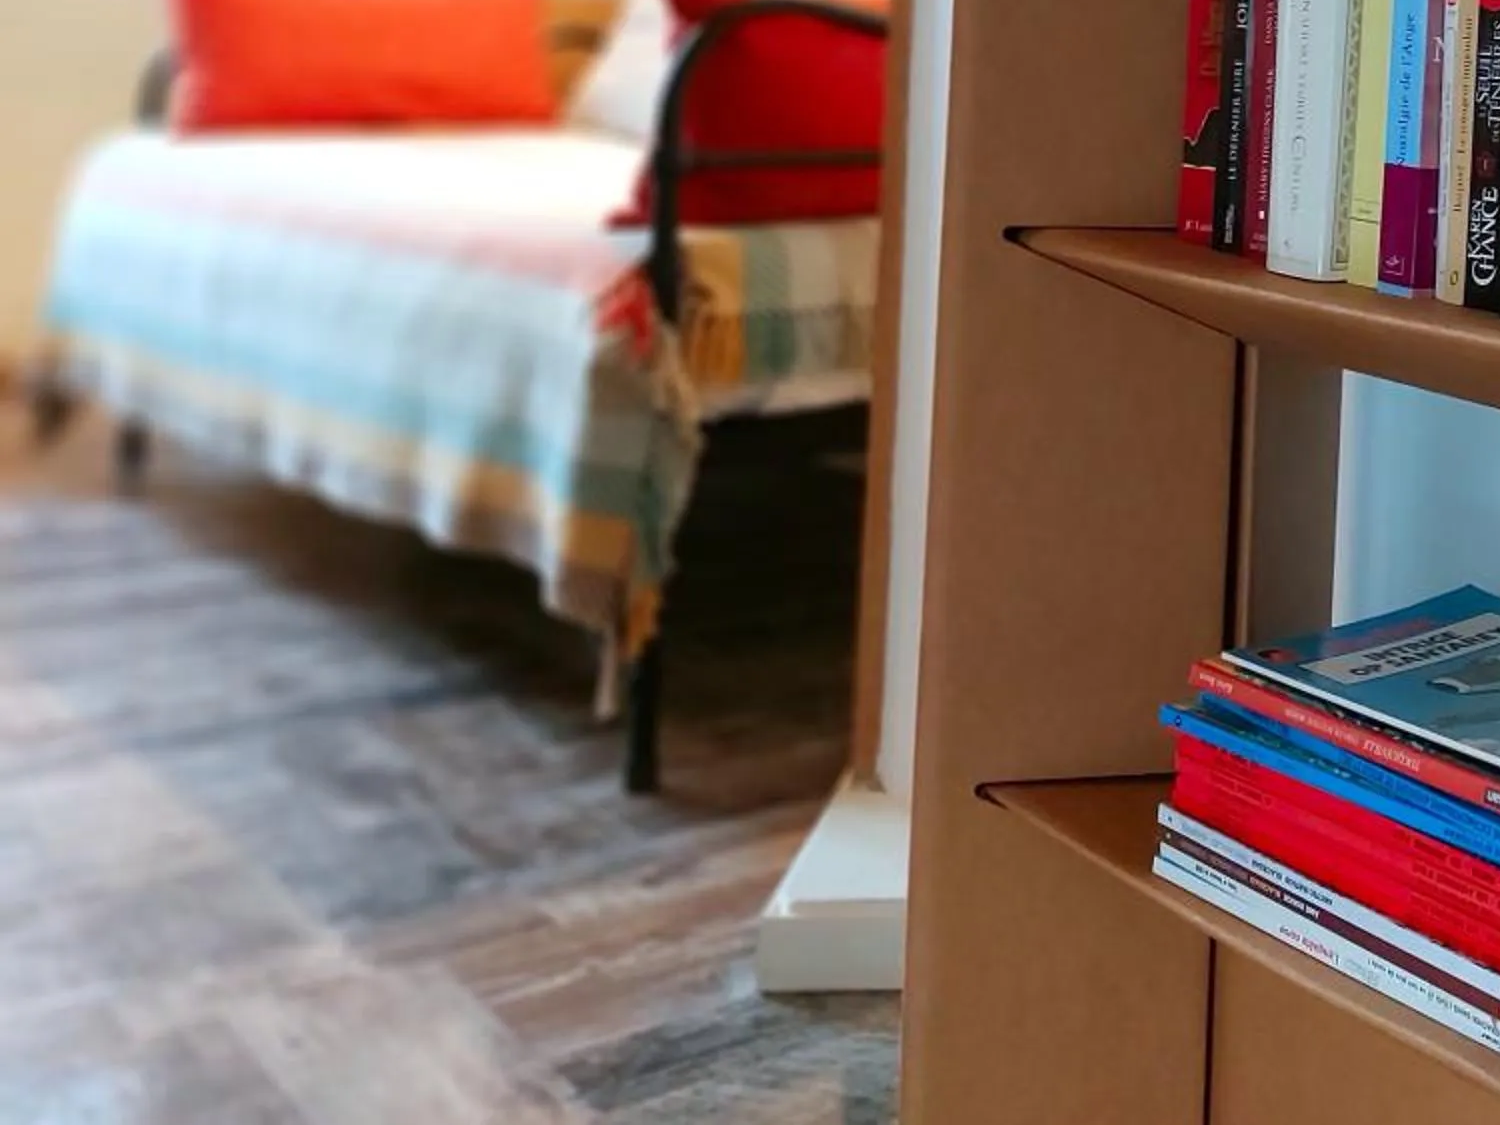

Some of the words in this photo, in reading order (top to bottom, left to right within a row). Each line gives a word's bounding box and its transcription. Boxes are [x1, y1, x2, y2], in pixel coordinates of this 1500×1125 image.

[1401, 13, 1415, 67] l'Ange
[1262, 69, 1274, 108] CLARK
[1399, 72, 1411, 91] de
[1475, 45, 1493, 103] SEUIL
[1228, 97, 1242, 162] DERNIER
[1227, 165, 1238, 181] LE
[1257, 167, 1269, 202] MARY
[1467, 199, 1482, 260] KAREN
[1470, 187, 1500, 286] CHANCE
[1363, 630, 1463, 661] INTRIGE
[1350, 663, 1383, 676] OP
